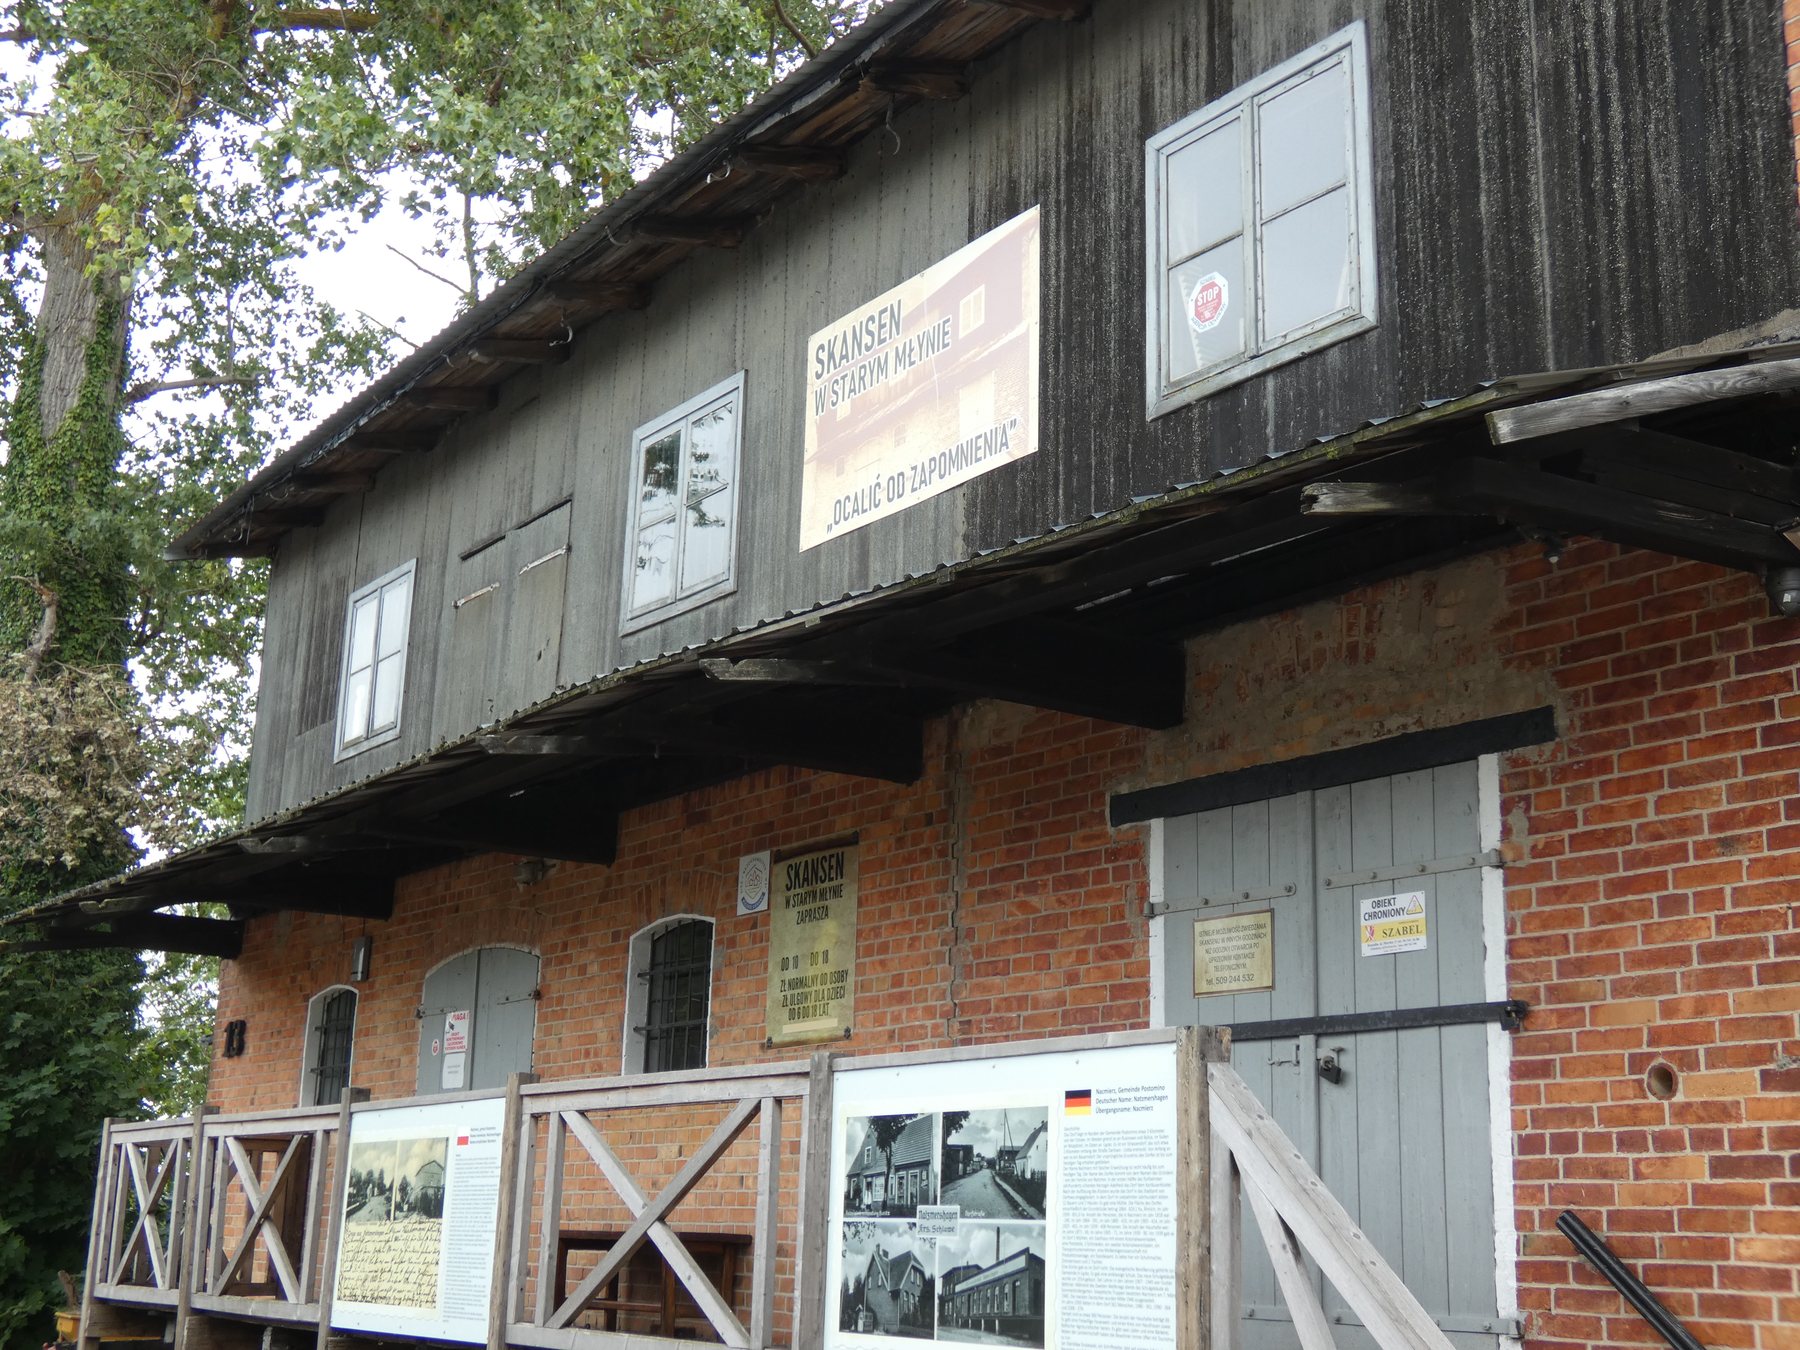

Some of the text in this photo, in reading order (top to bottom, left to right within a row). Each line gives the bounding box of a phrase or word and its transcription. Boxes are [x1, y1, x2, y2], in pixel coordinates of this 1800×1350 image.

[1197, 286, 1219, 306] STOP
[814, 299, 902, 381] SKANSEN
[814, 317, 951, 417] W STARYM MŁYNIE
[827, 418, 1018, 534] „OCALIĆ OD ZAPOMNIENIA”
[785, 851, 845, 892] SKANSEN
[785, 895, 791, 909] W
[792, 889, 818, 908] STARYM
[819, 883, 844, 902] MŁYNIE
[1371, 897, 1397, 909] OBIEKT
[796, 905, 829, 925] ZAPRASZA
[1363, 906, 1406, 921] CHRONIONY
[1382, 924, 1423, 938] SZABEL
[781, 949, 829, 971] OD 10 DO 18
[788, 973, 819, 991] NORMALNY
[820, 972, 828, 986] OD
[829, 969, 849, 985] OSOBY
[1216, 976, 1228, 984] 509
[1229, 975, 1241, 983] 244
[1241, 973, 1255, 982] 532
[789, 990, 813, 1006] ULGOWY
[814, 988, 825, 1003] DLA
[827, 985, 846, 1001] DZIECI
[788, 1007, 796, 1021] OD
[802, 1005, 810, 1019] DO
[223, 1020, 246, 1058] 13
[1117, 1086, 1141, 1094] Gemeinde
[1141, 1084, 1166, 1092] Postomino
[1095, 1097, 1118, 1105] Deutscher
[1134, 1094, 1169, 1102] Natzmershagen
[1095, 1106, 1132, 1114] Übergangsname:
